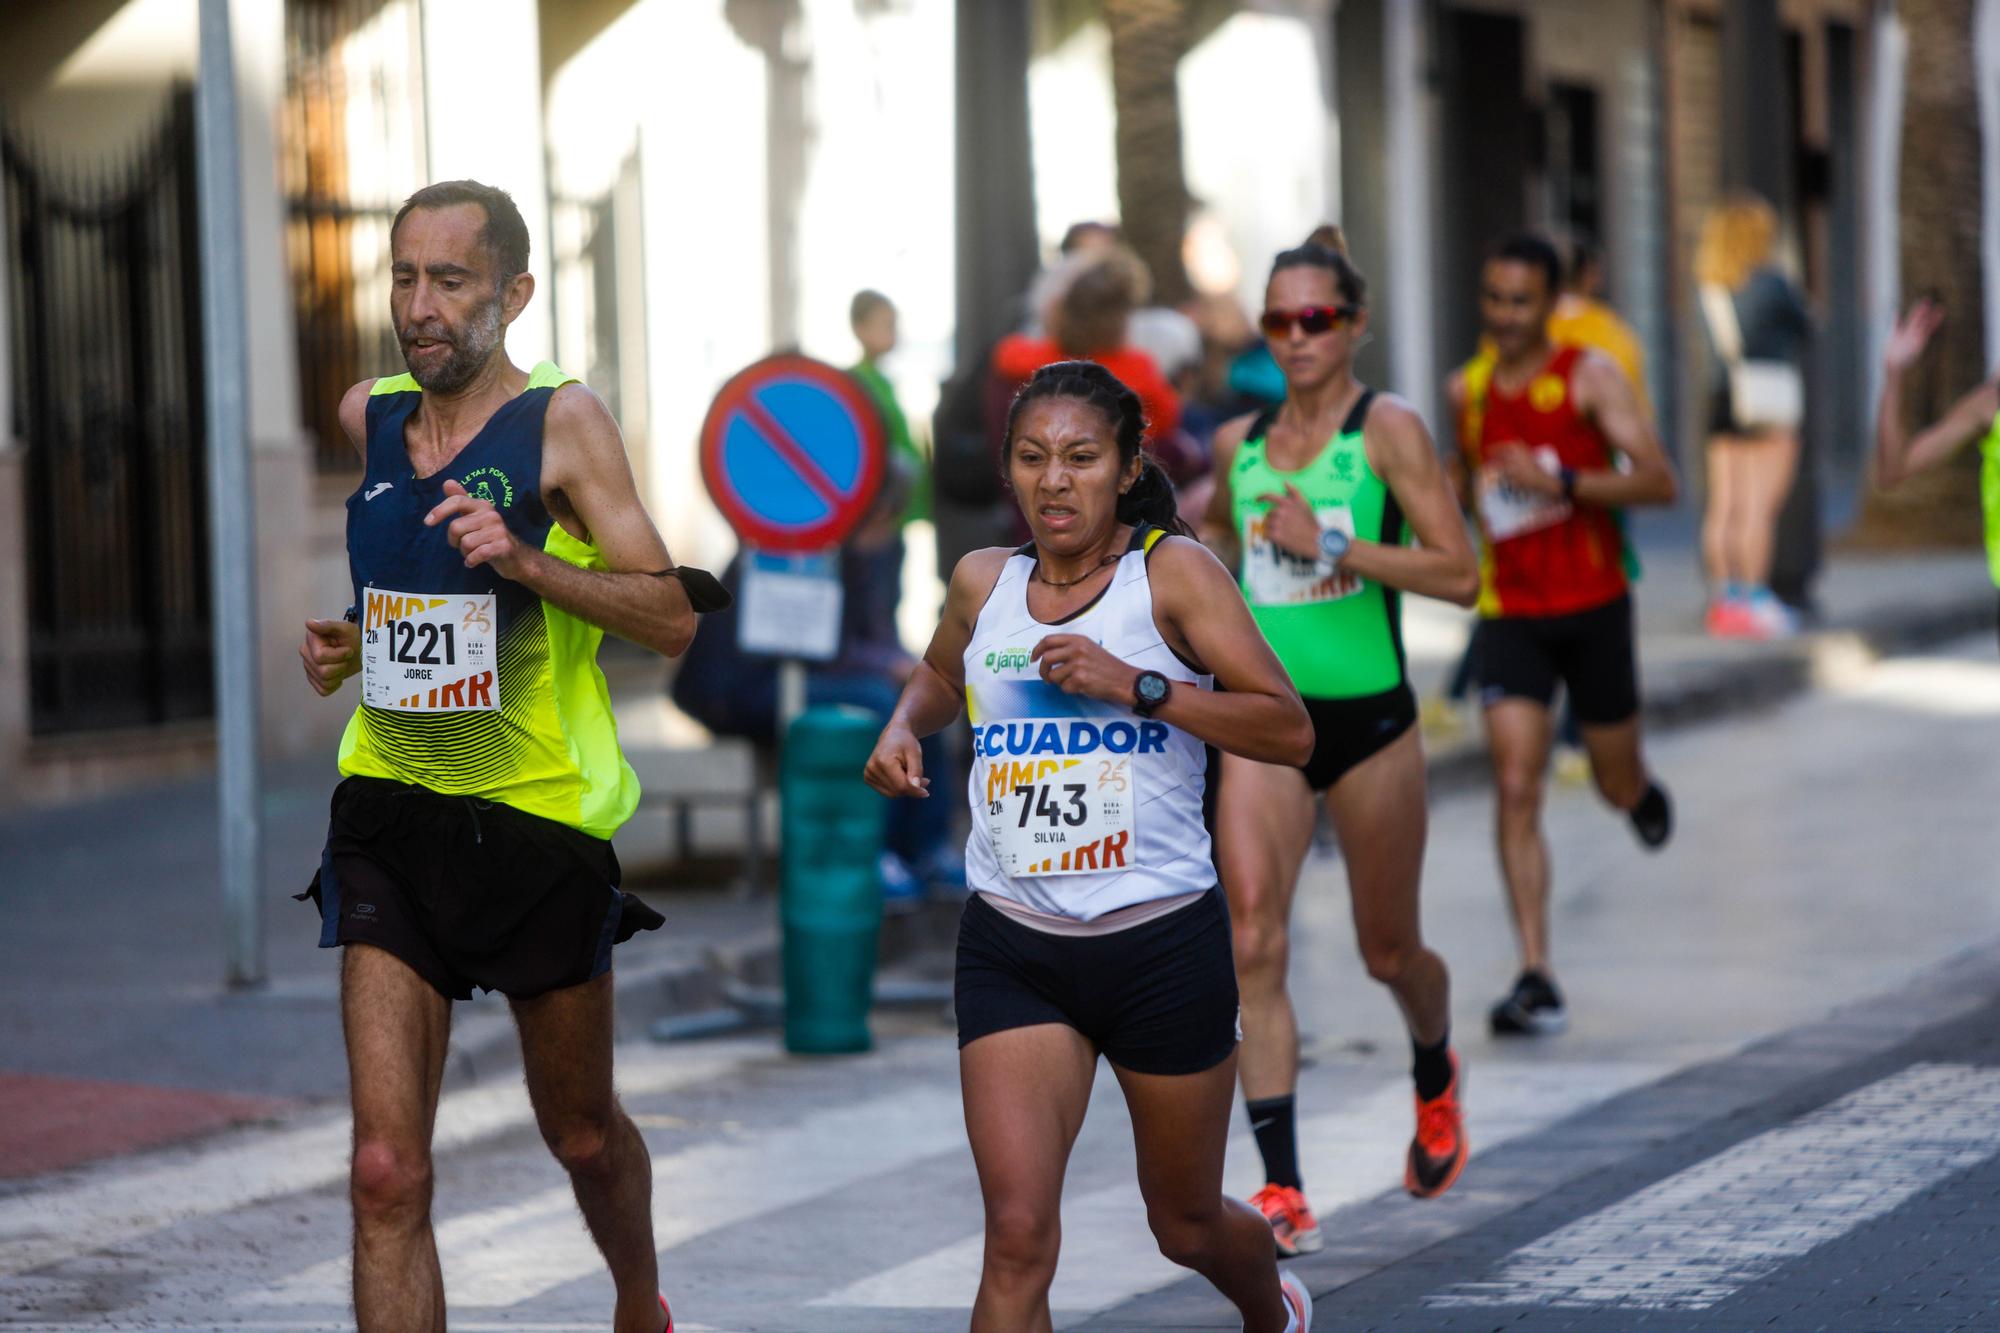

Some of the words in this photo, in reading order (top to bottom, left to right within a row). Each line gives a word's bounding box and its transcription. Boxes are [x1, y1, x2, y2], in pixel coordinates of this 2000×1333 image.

[460, 468, 487, 487] LETAS
[488, 467, 514, 508] POPULARES
[387, 620, 455, 665] 1221
[404, 668, 433, 680] JORGE
[992, 650, 1032, 674] janpi
[974, 721, 1169, 757] ECUADOR
[1015, 783, 1088, 828] 743
[1034, 832, 1067, 843] SILVIA
